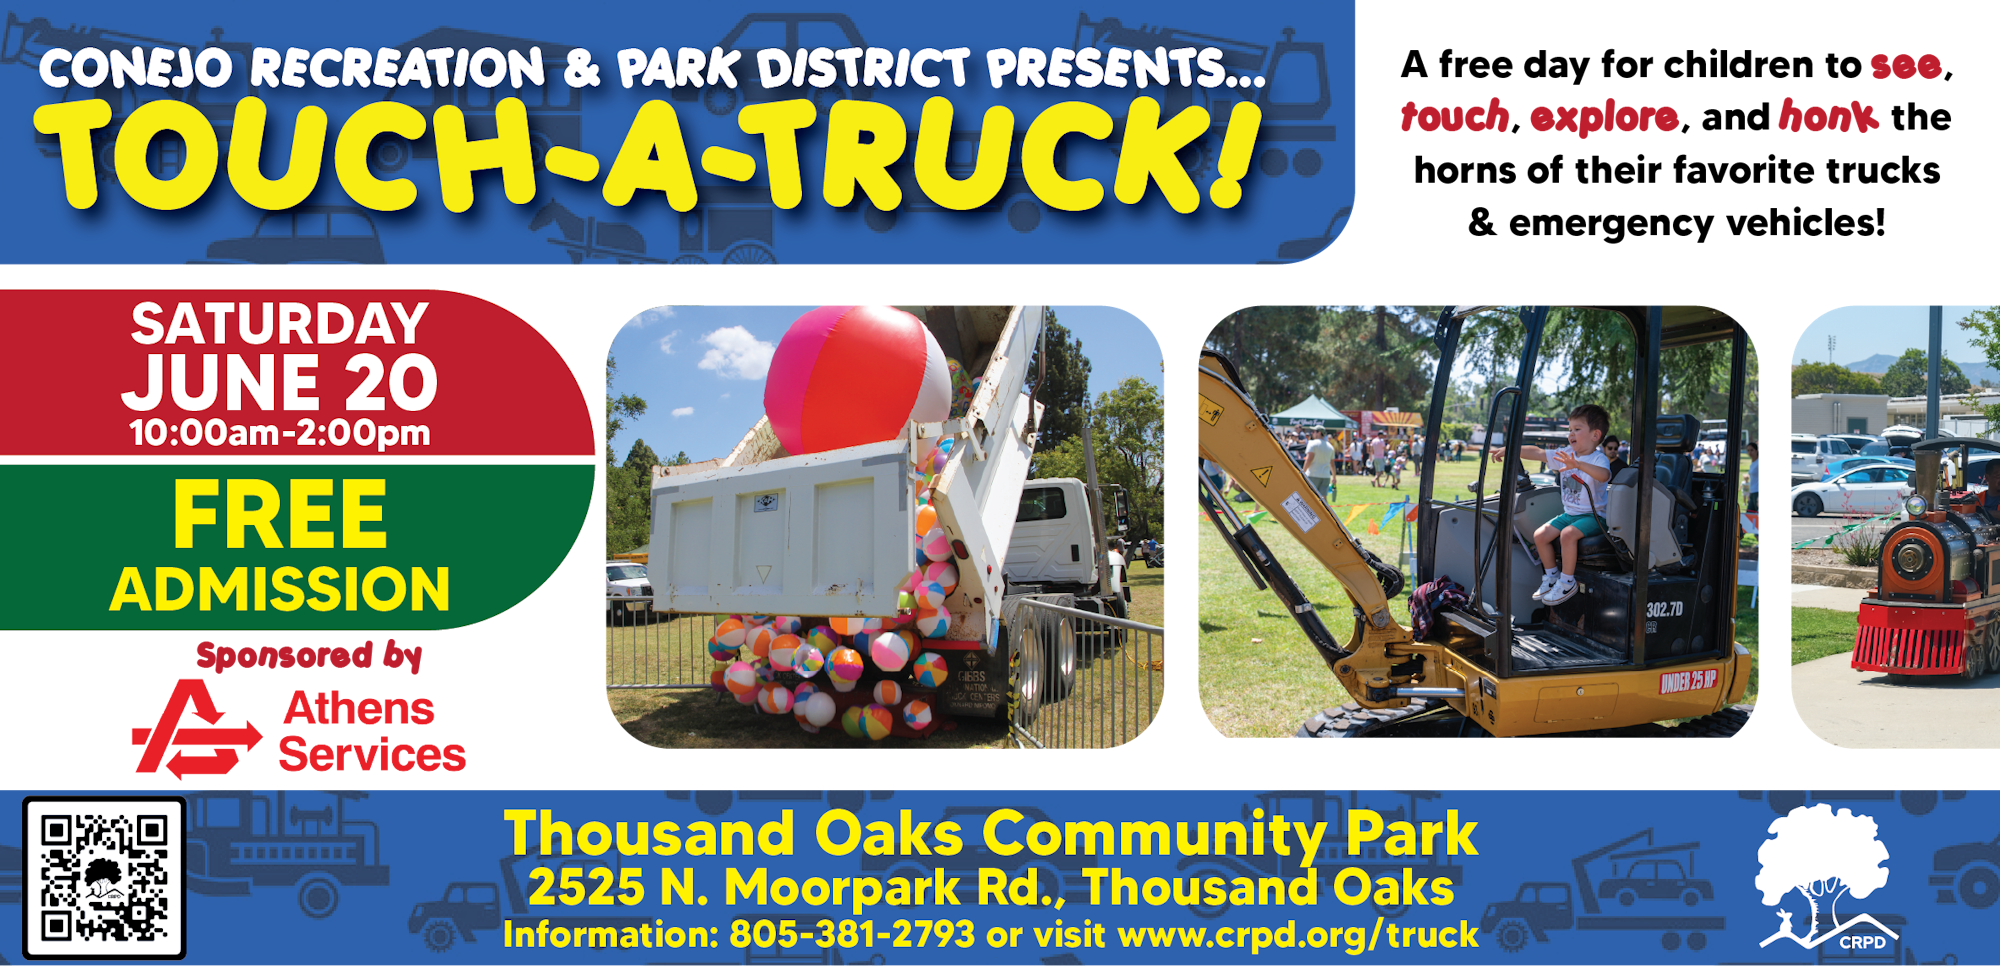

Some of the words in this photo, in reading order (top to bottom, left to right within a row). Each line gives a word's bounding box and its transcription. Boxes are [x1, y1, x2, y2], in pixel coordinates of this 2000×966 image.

[40, 47, 232, 88] CONEJO
[251, 47, 544, 88] RECREATION
[564, 48, 600, 87] &
[617, 47, 741, 88] PARK
[757, 47, 970, 88] DISTRICT
[987, 47, 1265, 88] PRESENTS...
[33, 96, 1263, 213] TOUCH-A-TRUCK!
[132, 302, 429, 344] SATURDAY
[121, 354, 319, 411] JUNE
[346, 353, 437, 411] 20
[129, 418, 429, 452] 10:00am-2:00pm
[176, 479, 386, 548] FREE
[109, 566, 448, 611] ADMISSION
[1646, 601, 1684, 618] 302.7D
[197, 641, 373, 674] Sponsored
[383, 639, 422, 674] by
[1661, 672, 1690, 694] UNDER
[1690, 671, 1703, 690] 25
[1703, 670, 1717, 688] HP
[284, 691, 434, 724] Athens
[279, 736, 466, 771] Services
[504, 810, 793, 856] Thousand
[816, 809, 963, 855] Oaks
[983, 808, 1327, 867] Community
[1348, 810, 1478, 856] Park
[529, 867, 644, 905] 2525
[662, 868, 707, 905] N.
[726, 867, 961, 915] Moorpark
[979, 867, 1065, 910] Rd.,
[1082, 867, 1317, 905] Thousand
[1334, 867, 1454, 905] Oaks
[505, 919, 717, 948] Information:
[730, 919, 974, 948] 805-381-2793
[987, 927, 1022, 948] or
[1033, 919, 1105, 948] visit
[1118, 917, 1479, 955] www.crpd.org/truck
[1840, 936, 1886, 948] CRPD
